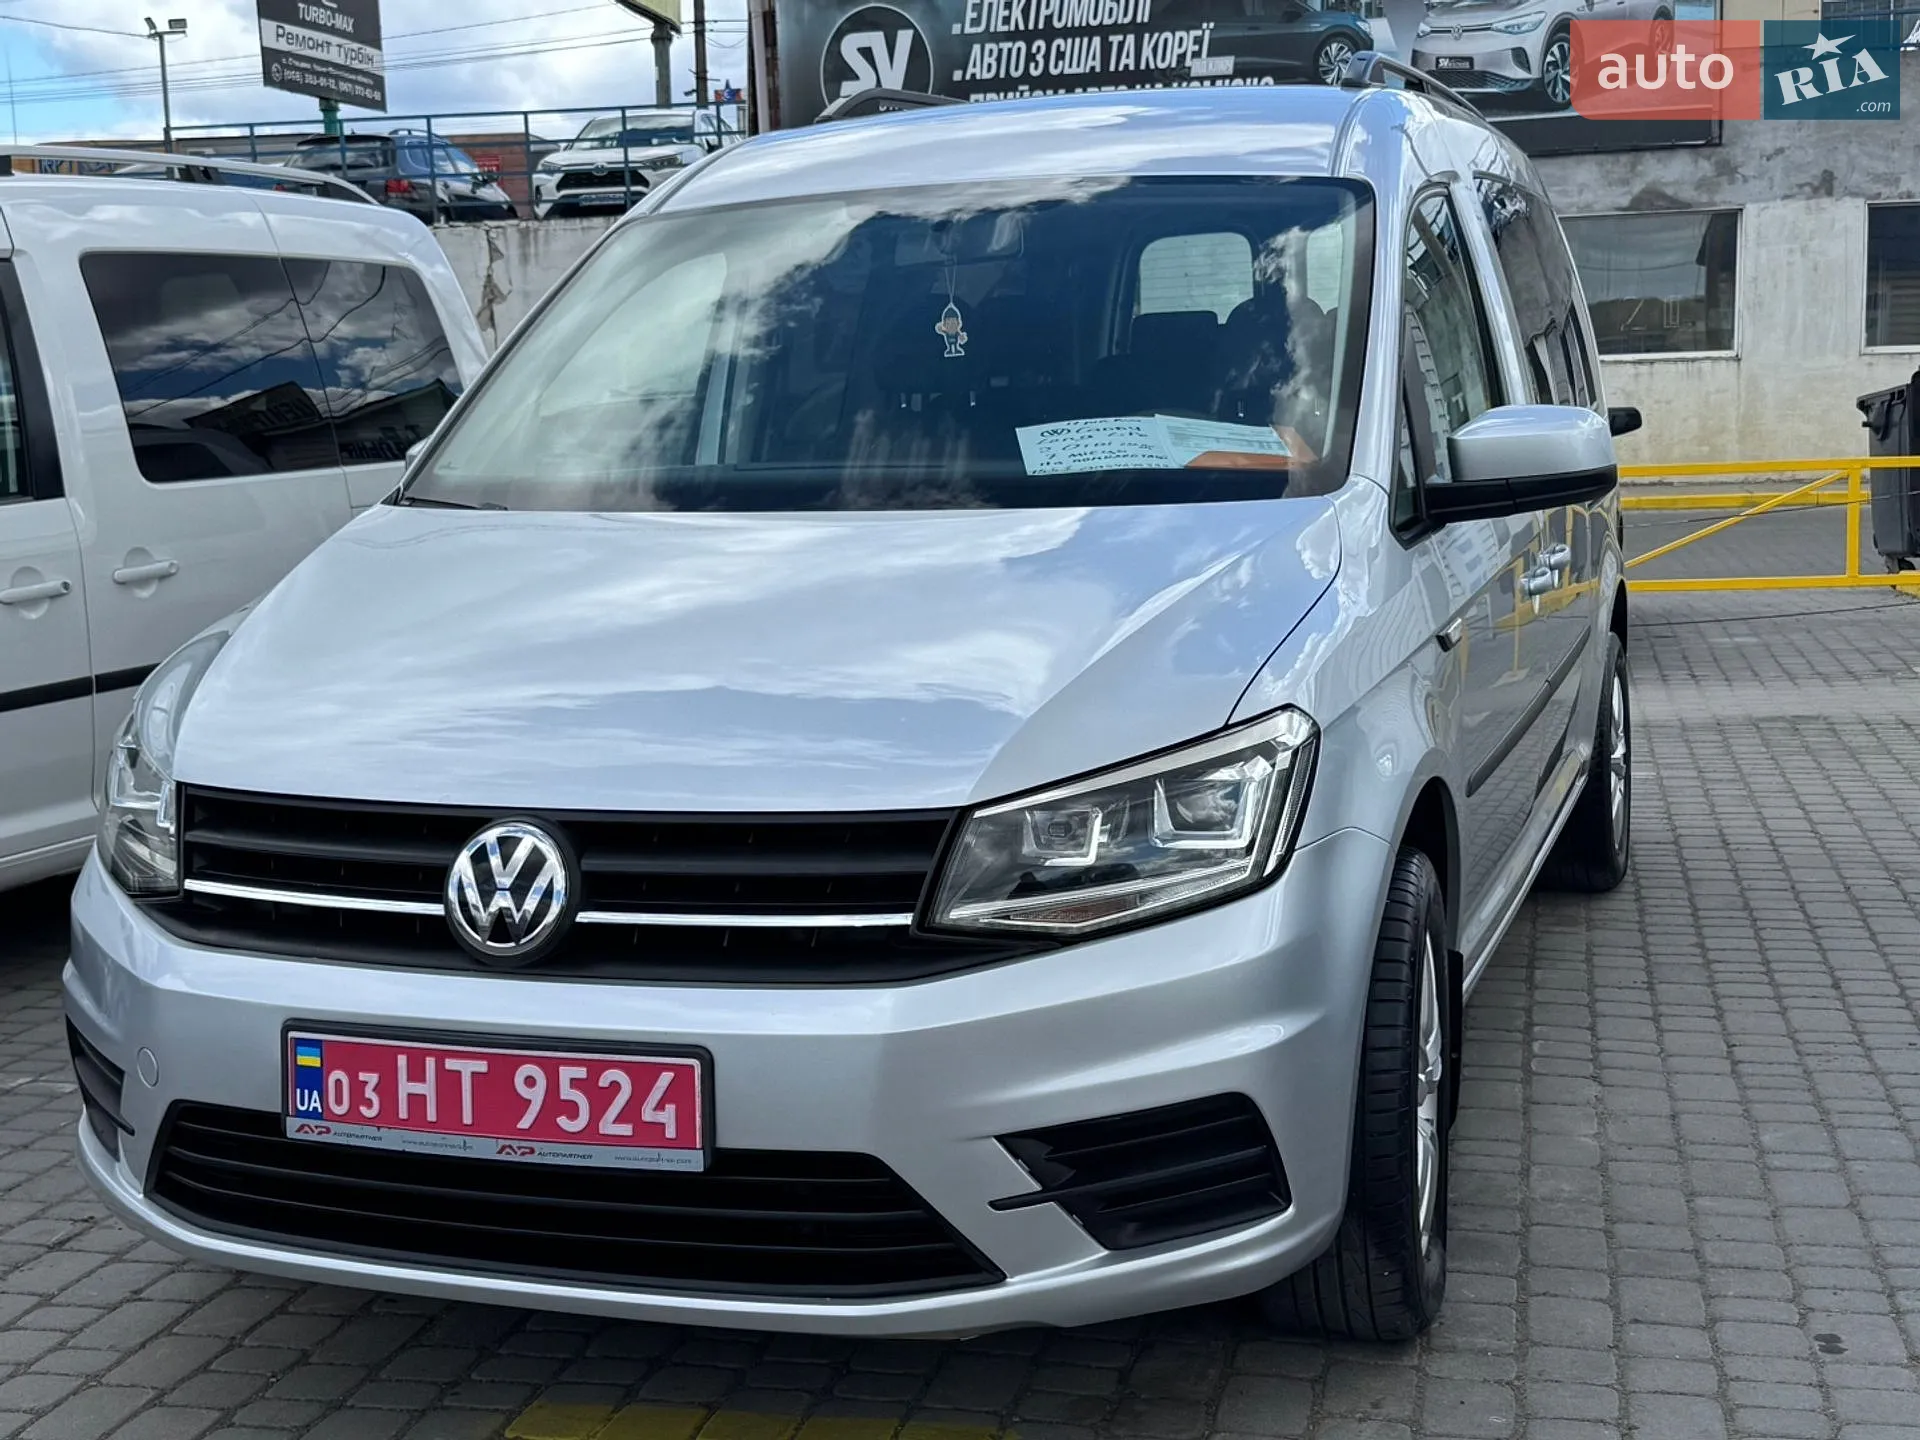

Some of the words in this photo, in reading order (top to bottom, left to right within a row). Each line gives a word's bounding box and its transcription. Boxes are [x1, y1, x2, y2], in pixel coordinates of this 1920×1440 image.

[298, 3, 355, 33] TURBO-MAX
[275, 24, 333, 54] Ремонт
[965, 40, 1027, 81] АВТО
[1049, 35, 1101, 76] США
[1108, 34, 1136, 72] ТА
[1140, 22, 1215, 70] КОРЕЇ
[296, 1088, 322, 1113] UA
[327, 1069, 381, 1120] 03
[396, 1053, 489, 1126] HT
[513, 1062, 678, 1140] 9524
